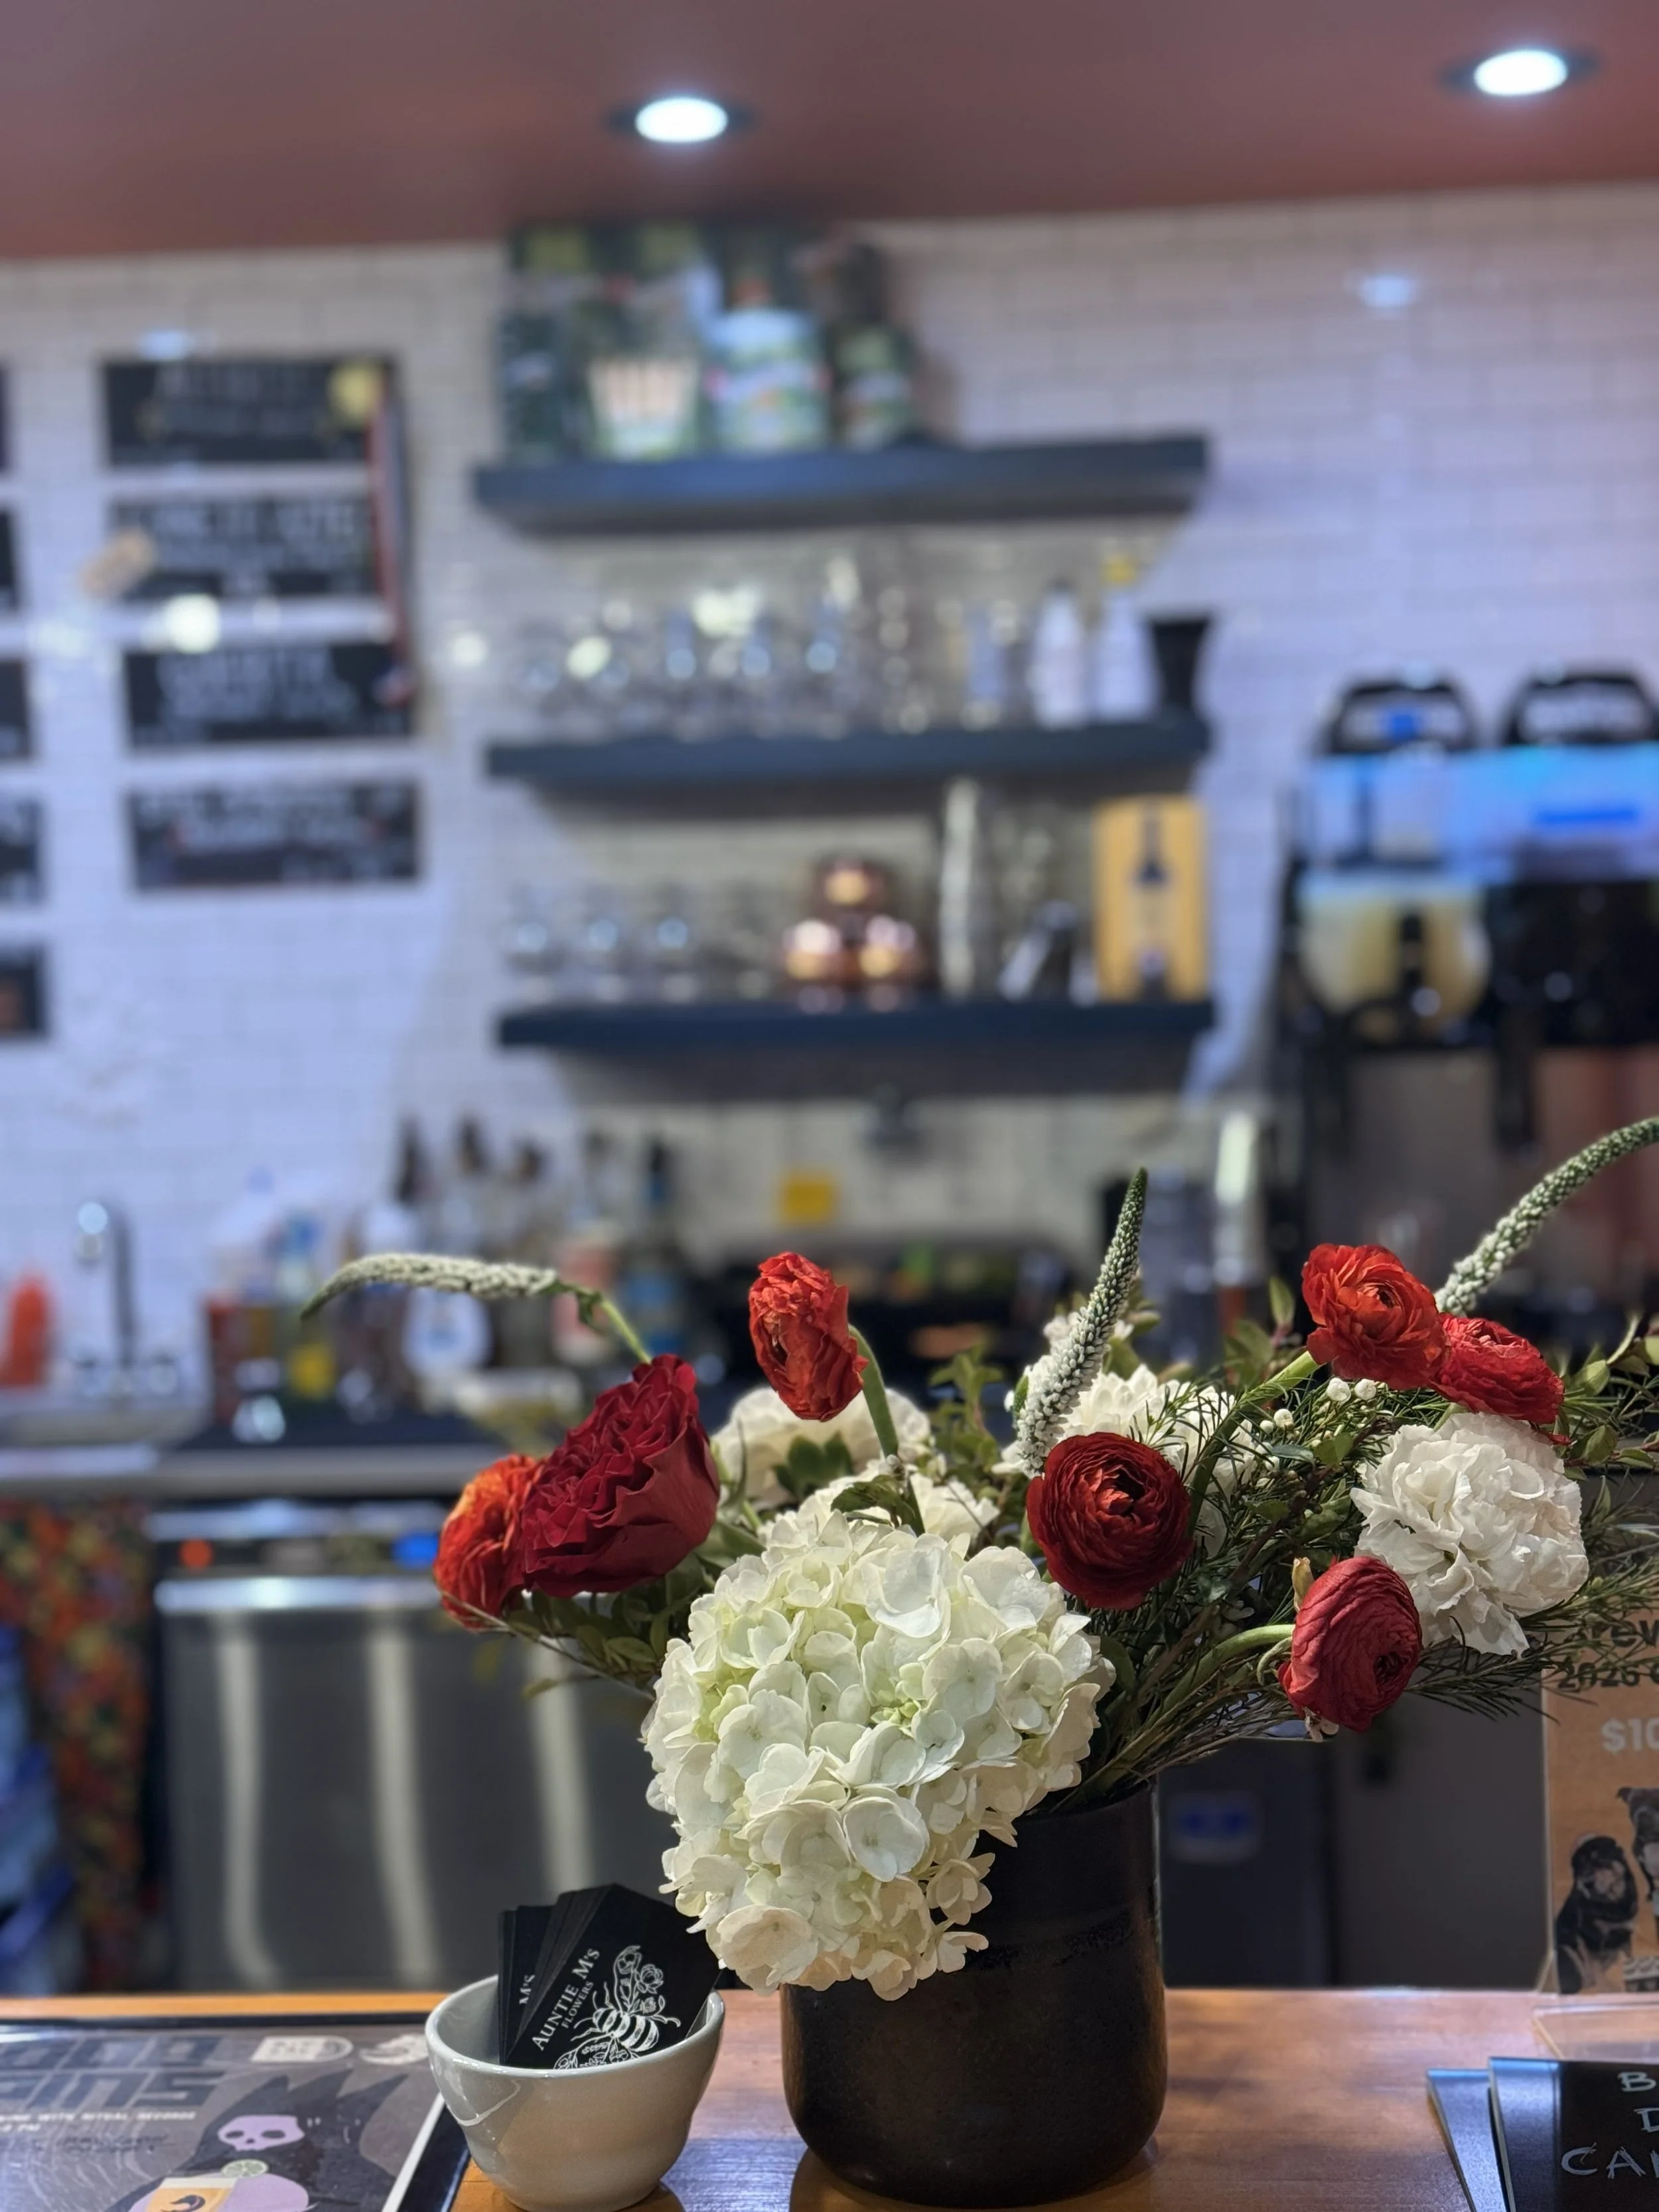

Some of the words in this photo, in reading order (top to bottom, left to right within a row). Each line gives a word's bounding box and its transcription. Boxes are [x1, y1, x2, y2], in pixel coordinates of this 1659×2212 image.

[532, 1984, 579, 2051] AUNTIE
[571, 1949, 600, 1980] M'S
[561, 1980, 594, 2029] FLOWERS
[1561, 2142, 1659, 2179] CA
